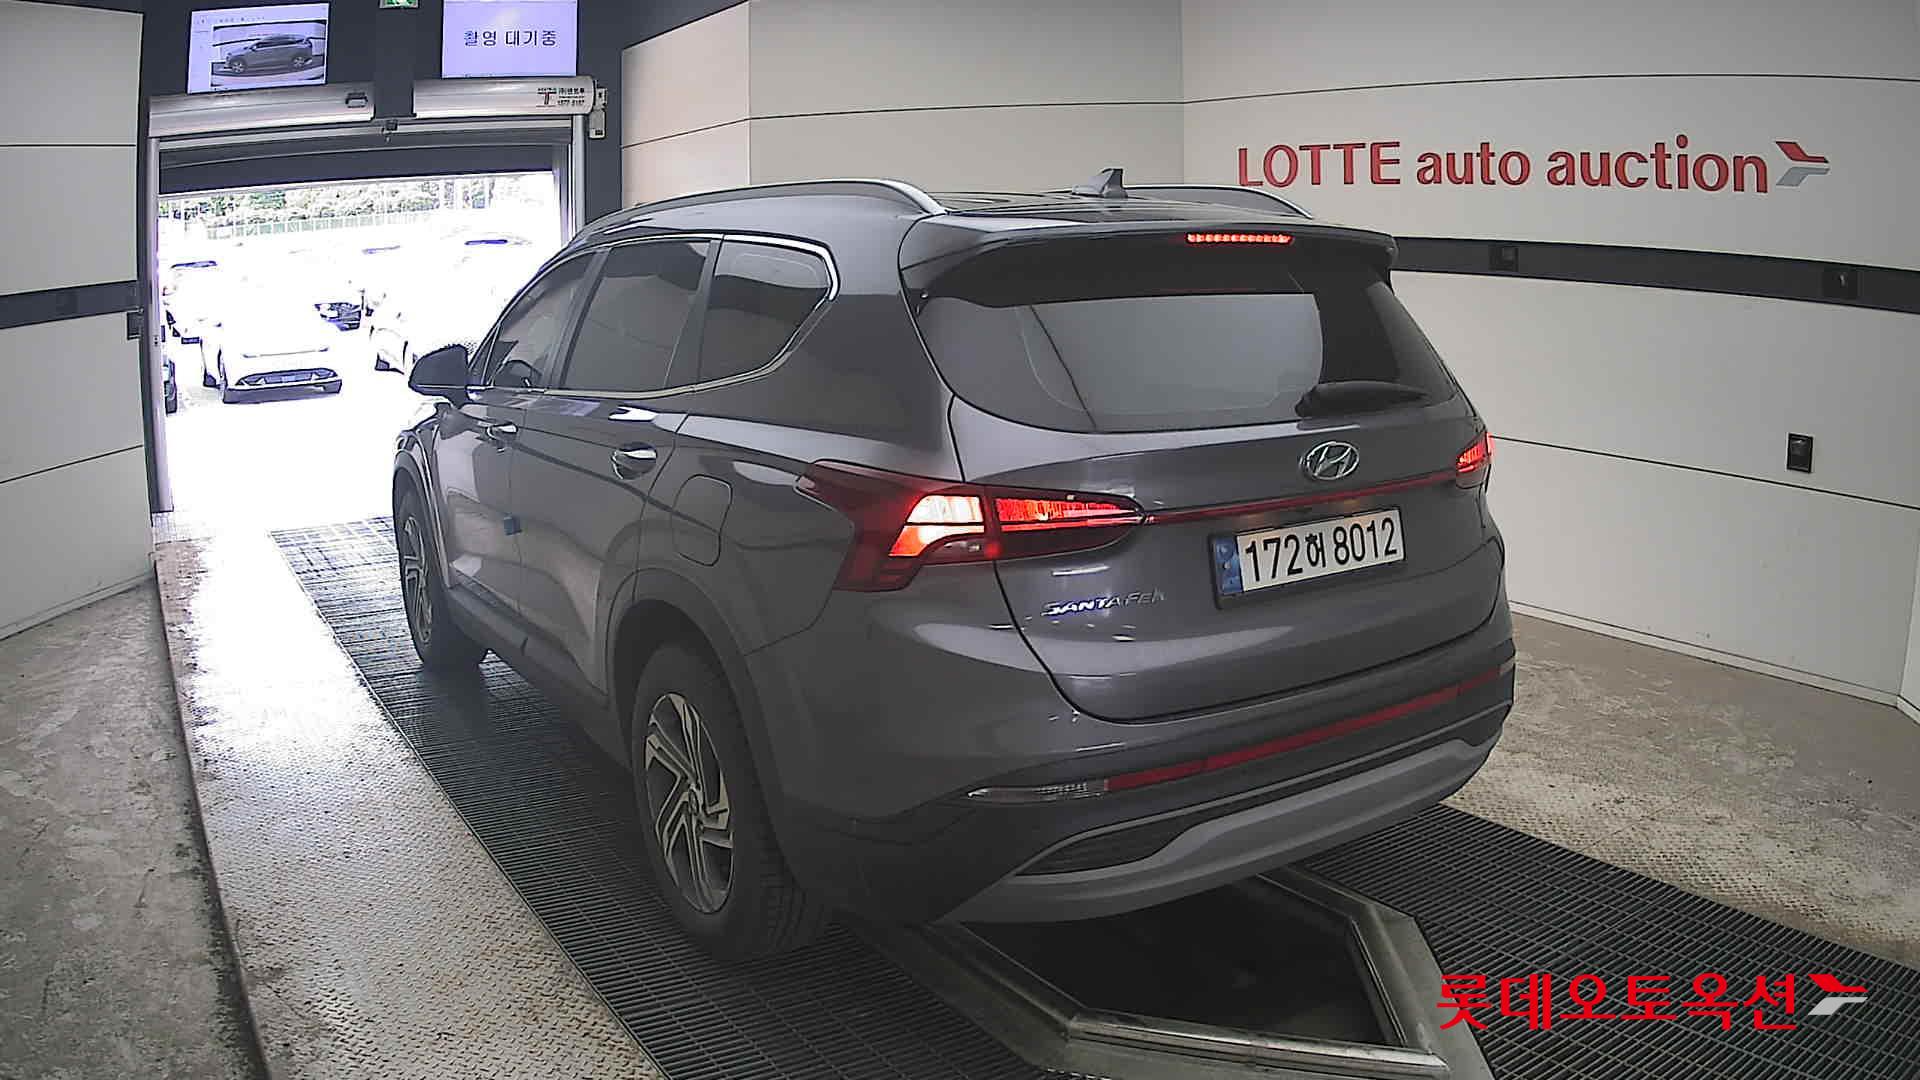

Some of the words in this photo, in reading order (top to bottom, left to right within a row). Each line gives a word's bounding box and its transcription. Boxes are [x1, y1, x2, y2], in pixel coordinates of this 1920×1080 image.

[464, 30, 497, 47] 촬영
[505, 30, 557, 47] 대기중
[1238, 141, 1401, 188] LOTTE
[1416, 142, 1531, 186] auto
[1547, 134, 1768, 193] auction
[1245, 531, 1326, 582] 172허
[1333, 517, 1397, 565] 8012
